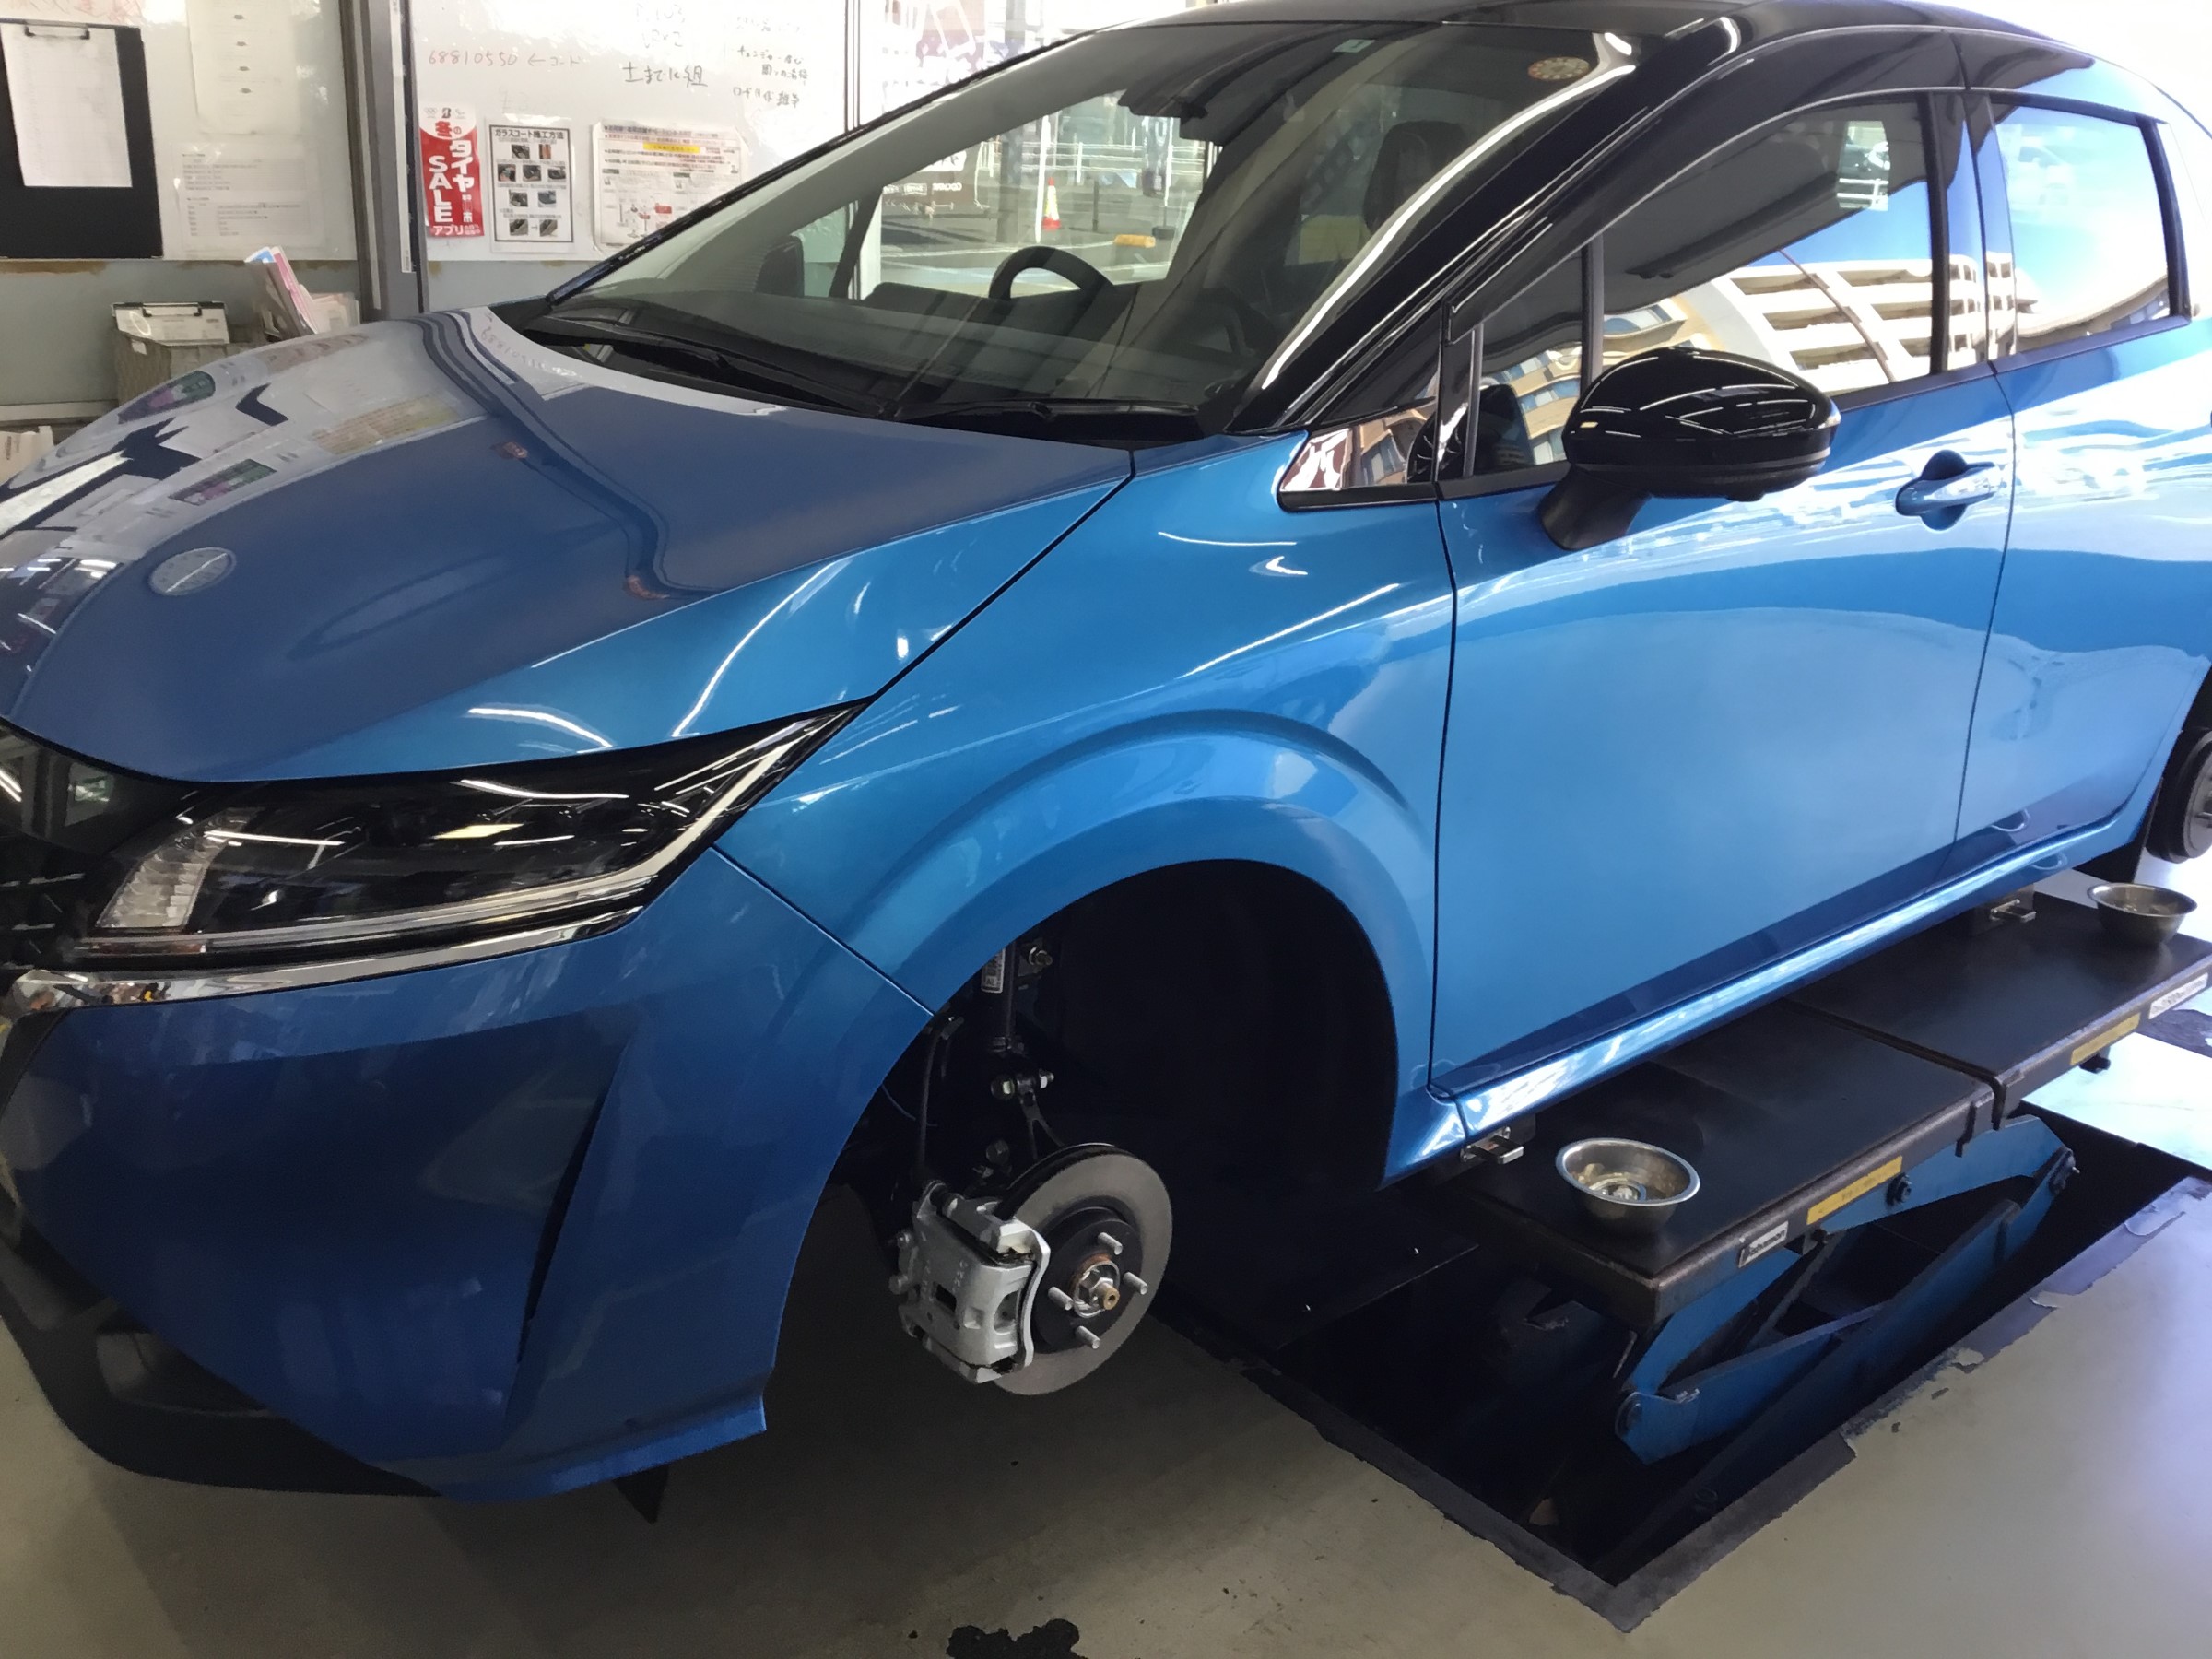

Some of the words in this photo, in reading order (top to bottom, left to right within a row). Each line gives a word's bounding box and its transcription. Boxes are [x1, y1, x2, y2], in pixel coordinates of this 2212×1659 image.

[429, 50, 518, 66] 68810550
[429, 155, 453, 223] SALE
[432, 224, 464, 236] アプリ
